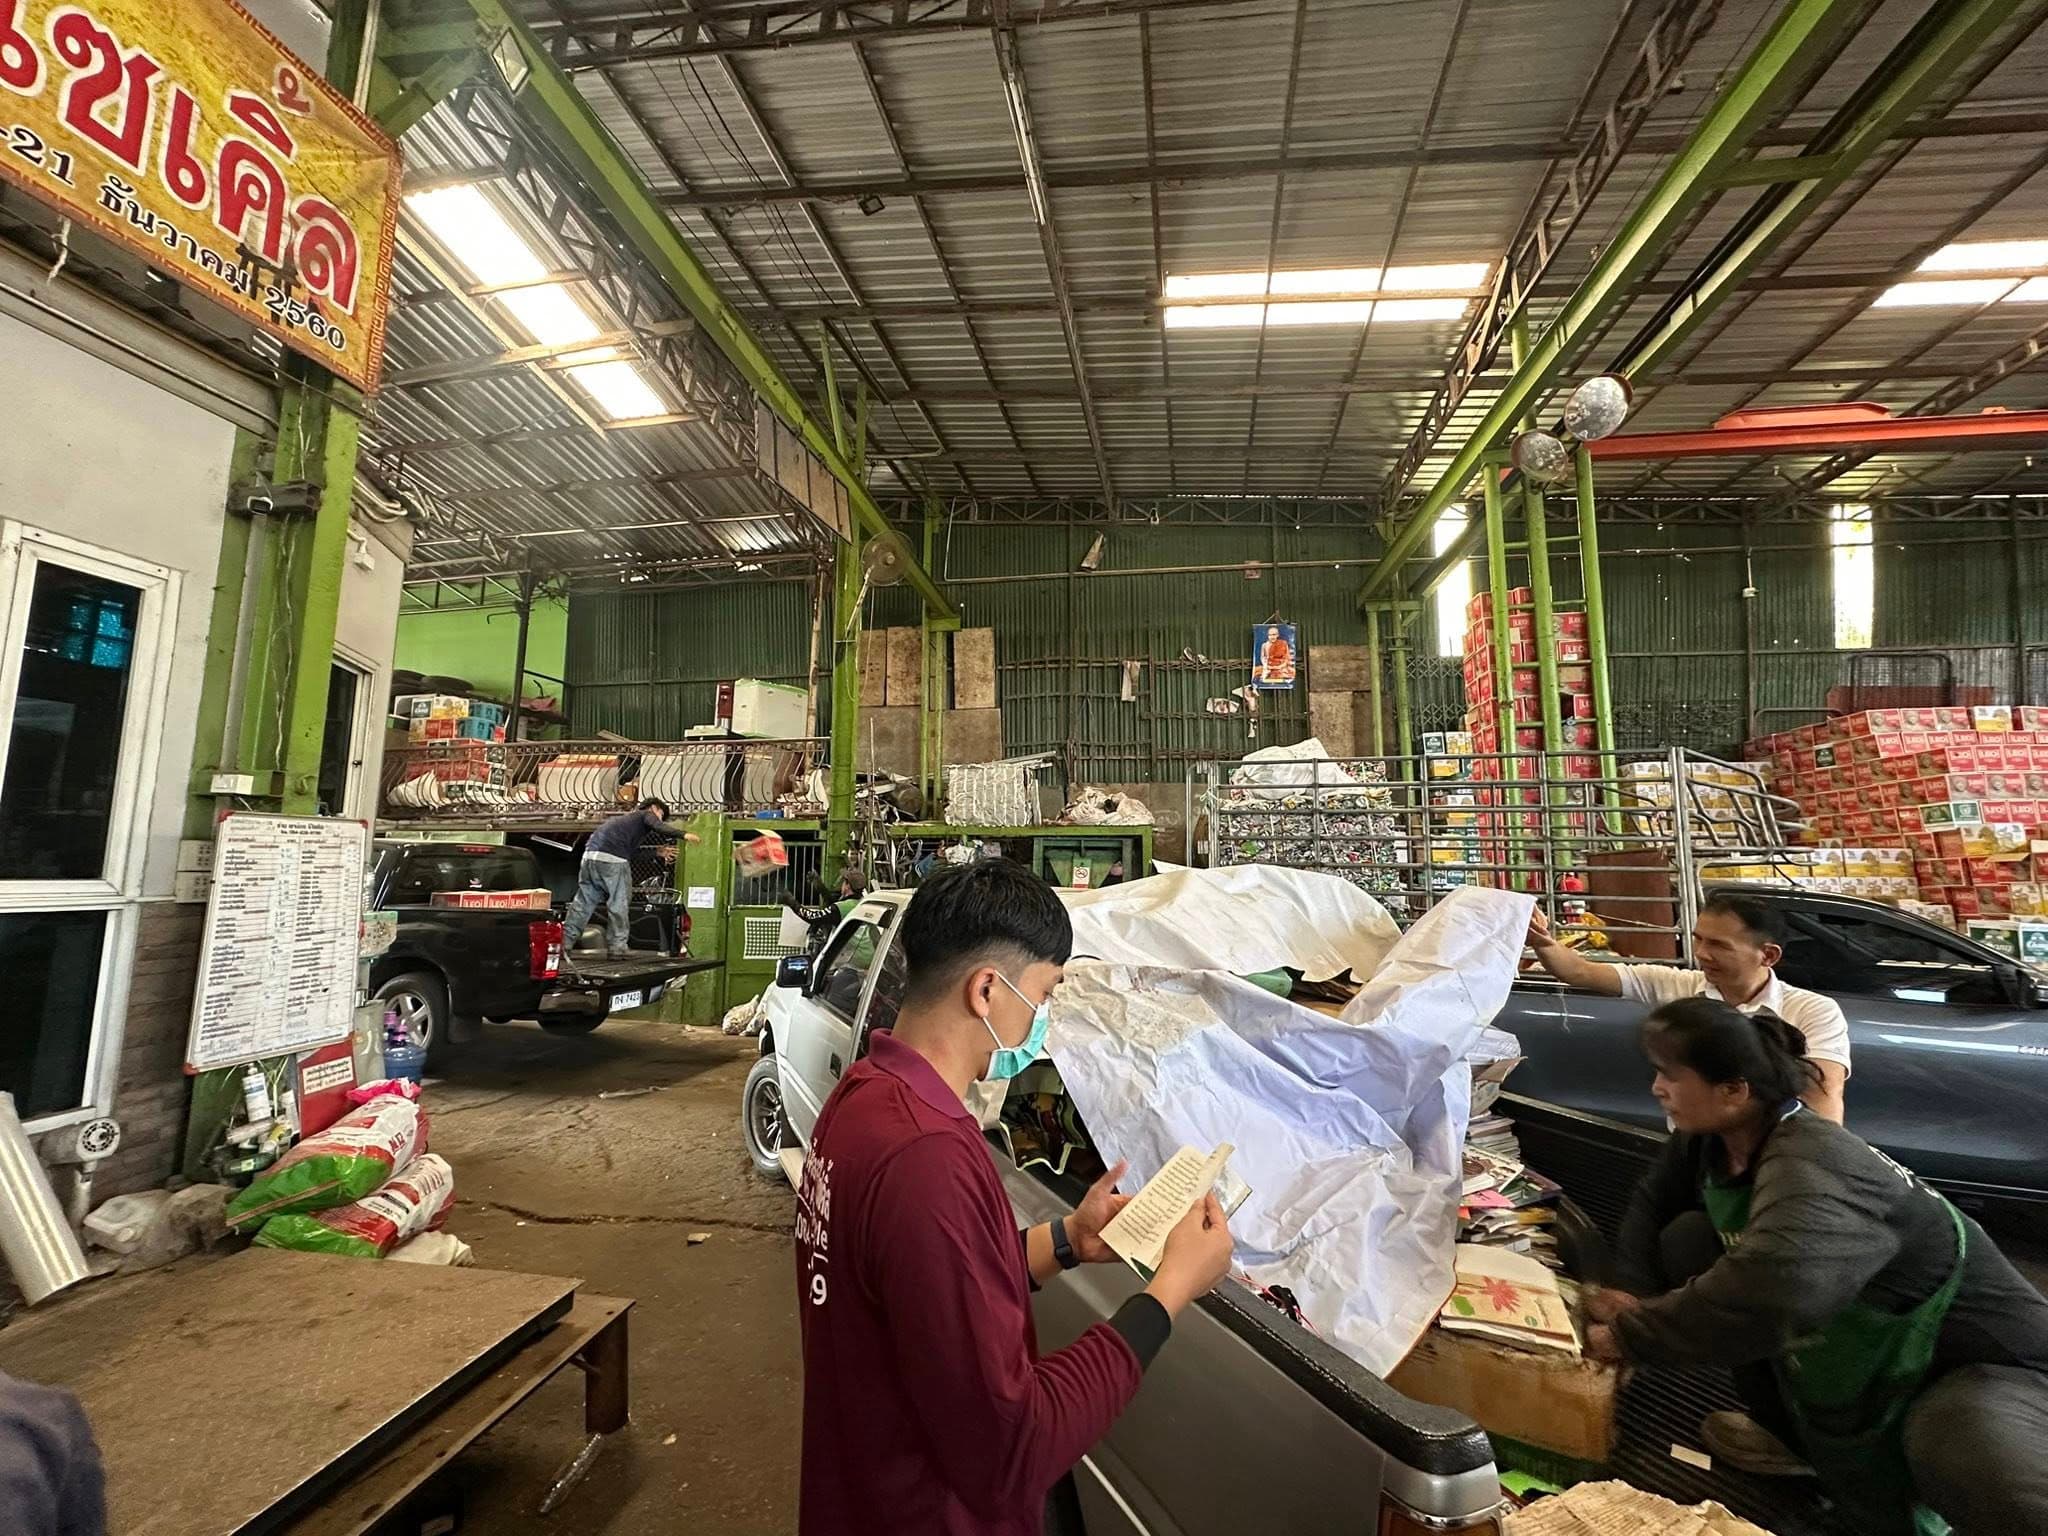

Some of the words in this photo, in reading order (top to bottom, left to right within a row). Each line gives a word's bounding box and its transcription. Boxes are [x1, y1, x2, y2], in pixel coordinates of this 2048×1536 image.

[99, 175, 252, 294] ธันวาคม
[265, 287, 347, 350] 2560
[465, 900, 481, 908] LEO
[491, 900, 506, 908] LEO
[512, 899, 527, 907] LEO
